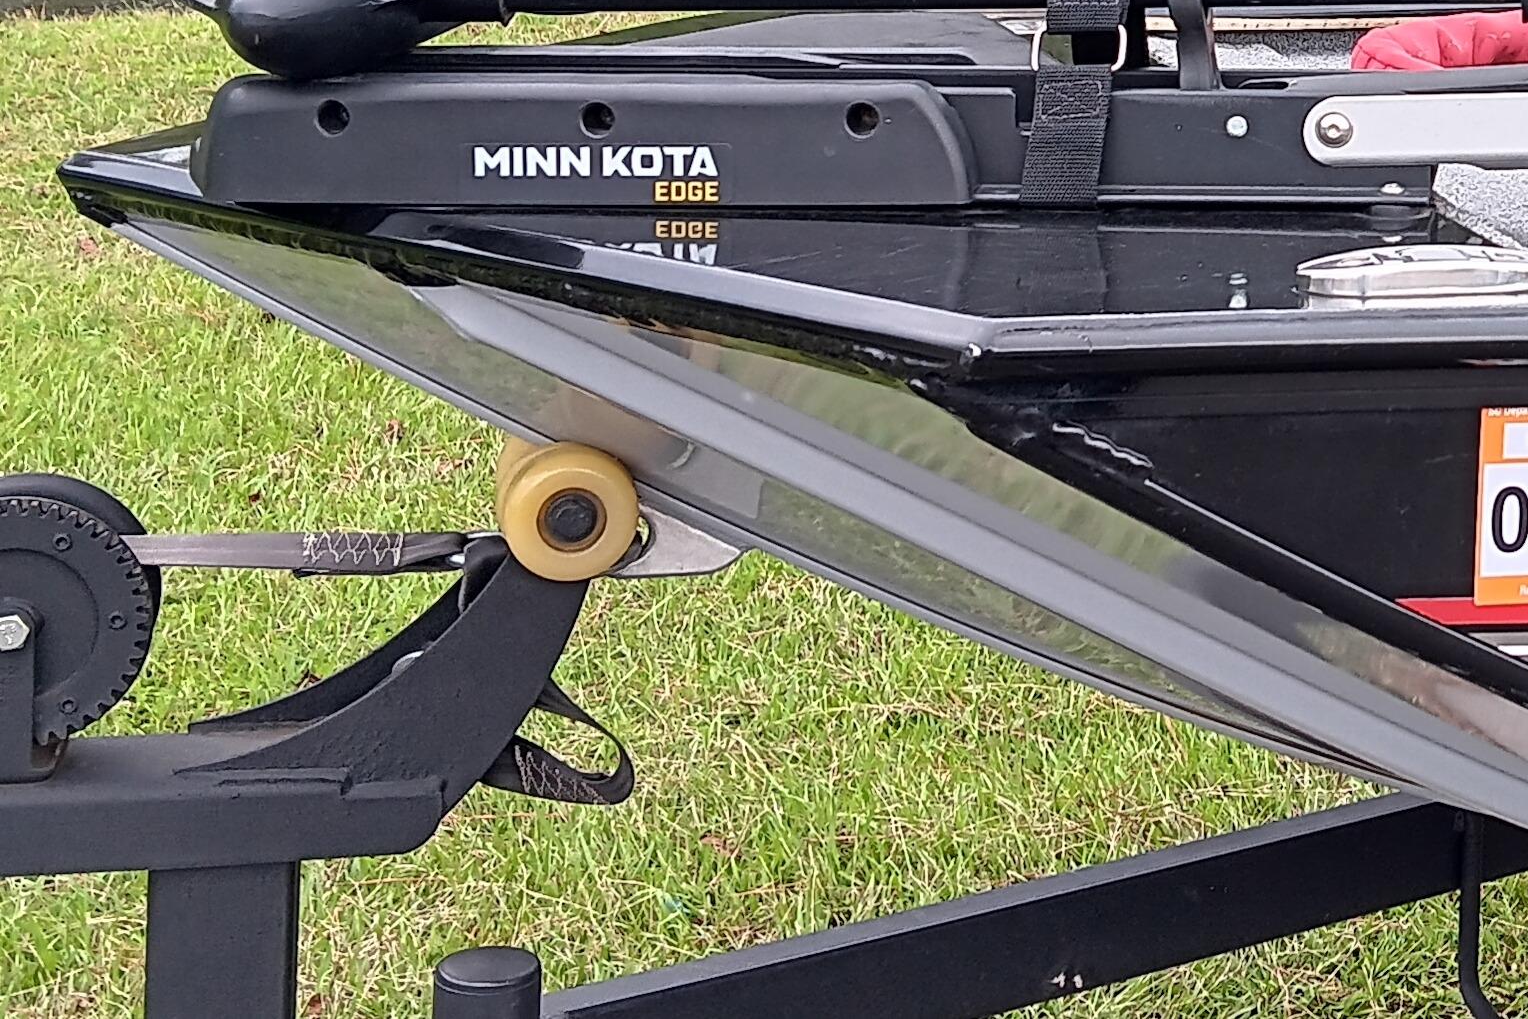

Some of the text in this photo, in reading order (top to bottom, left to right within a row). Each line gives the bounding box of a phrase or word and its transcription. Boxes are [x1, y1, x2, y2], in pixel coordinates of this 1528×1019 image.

[473, 145, 718, 177] MINN KOTA
[655, 181, 719, 202] EDGE
